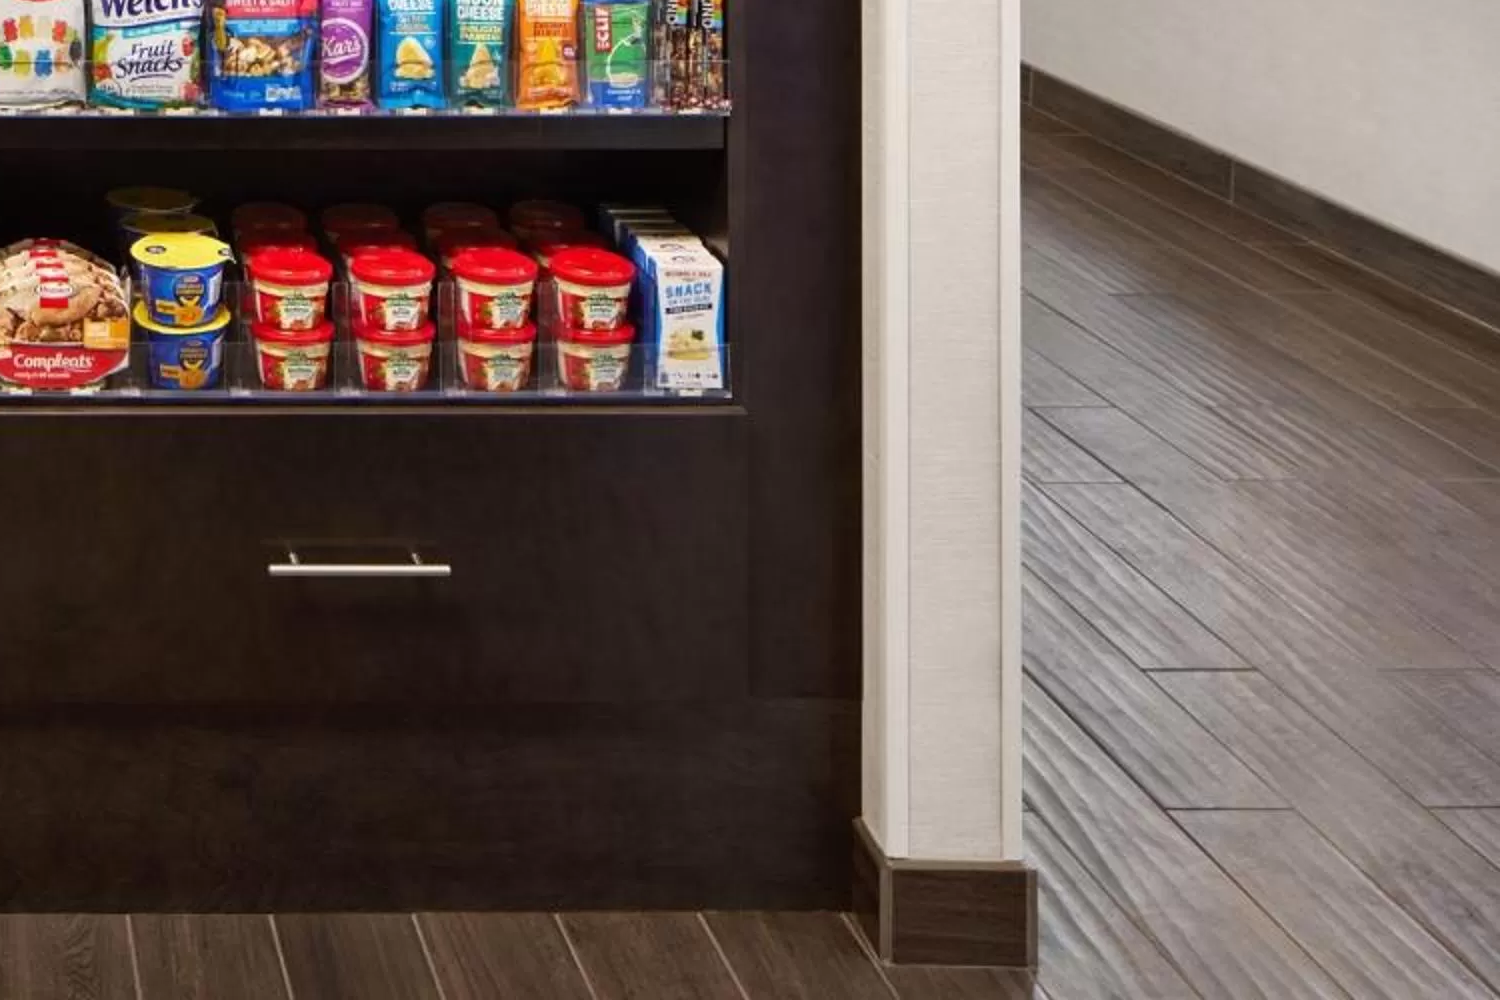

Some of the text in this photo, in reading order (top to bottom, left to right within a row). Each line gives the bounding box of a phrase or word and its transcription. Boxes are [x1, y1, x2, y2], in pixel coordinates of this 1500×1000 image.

[457, 5, 504, 21] CHEESE
[132, 39, 175, 58] Fruit
[116, 55, 184, 80] Snacks
[665, 282, 712, 299] SNACK
[13, 353, 93, 372] Compleats
